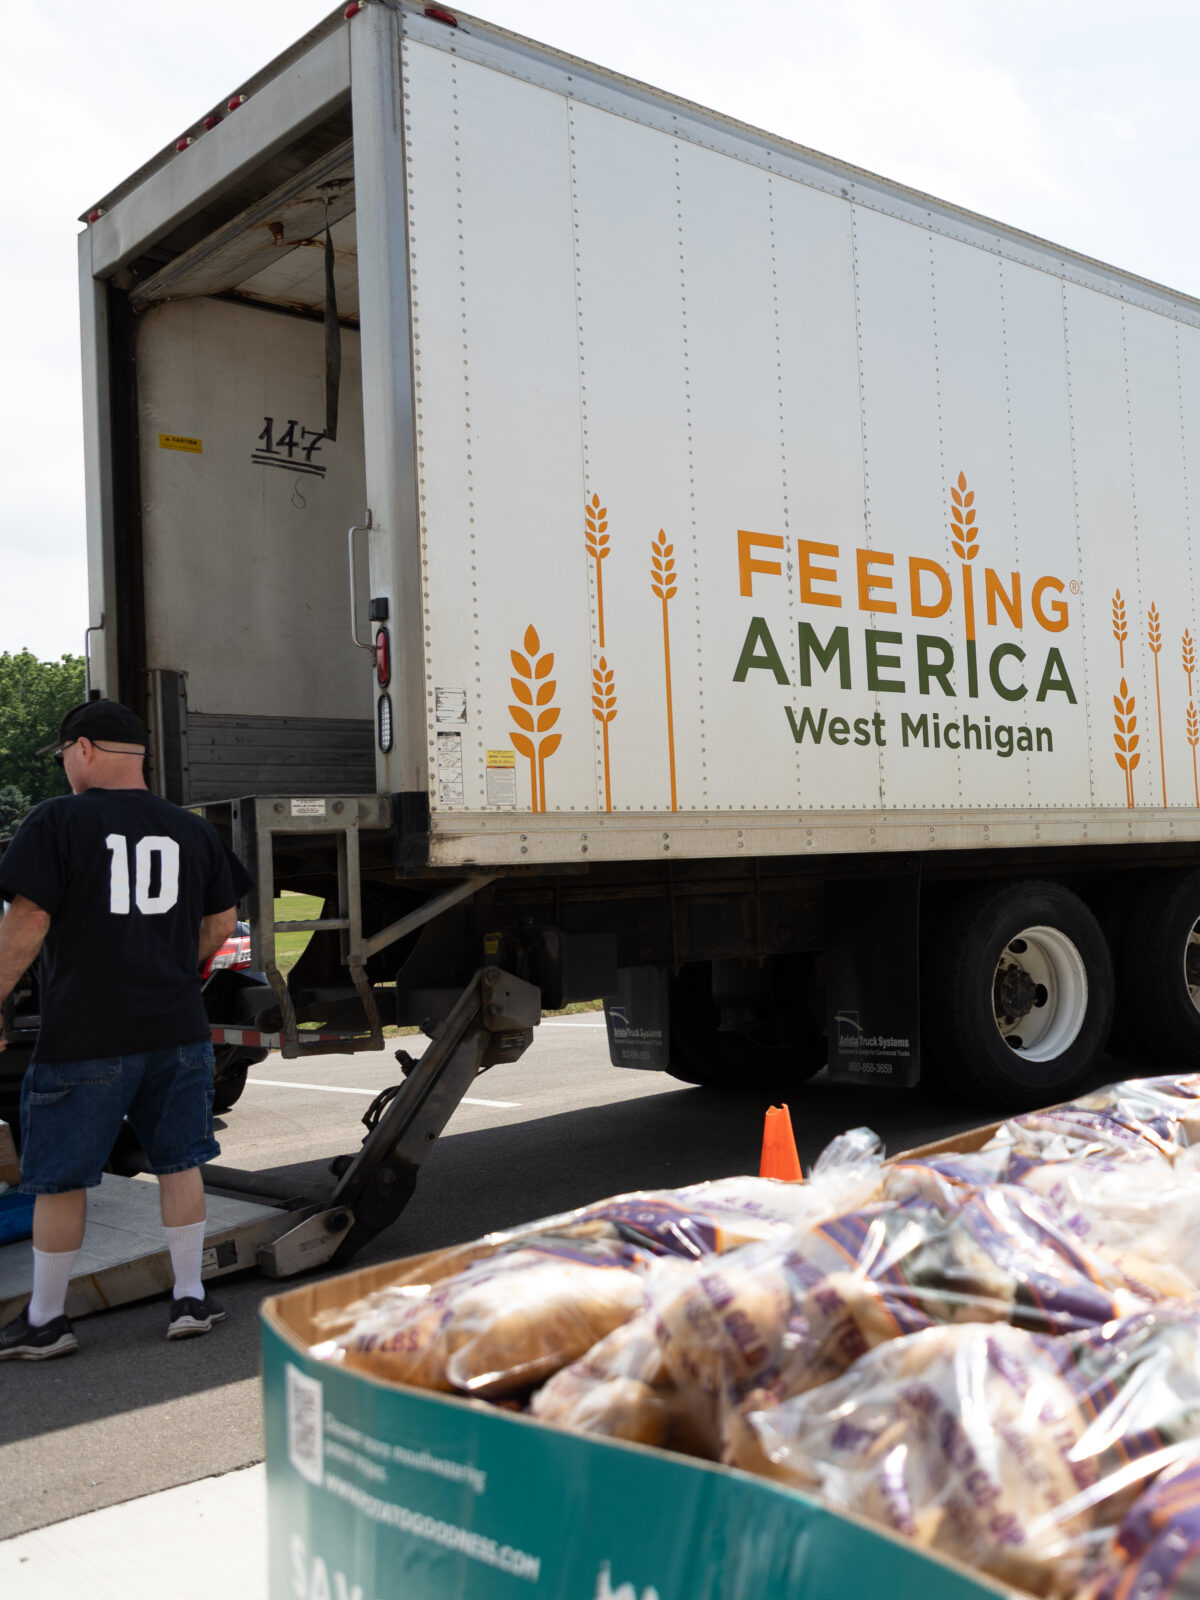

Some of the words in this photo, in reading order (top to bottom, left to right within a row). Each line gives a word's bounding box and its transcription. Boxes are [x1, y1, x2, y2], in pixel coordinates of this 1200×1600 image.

[255, 416, 327, 462] 147
[737, 530, 1070, 640] FEEDING
[732, 616, 1078, 704] AMERICA
[784, 706, 887, 746] West
[901, 712, 1054, 757] Michigan
[105, 833, 180, 915] 10
[859, 1035, 878, 1047] Truck
[878, 1036, 910, 1049] Systems
